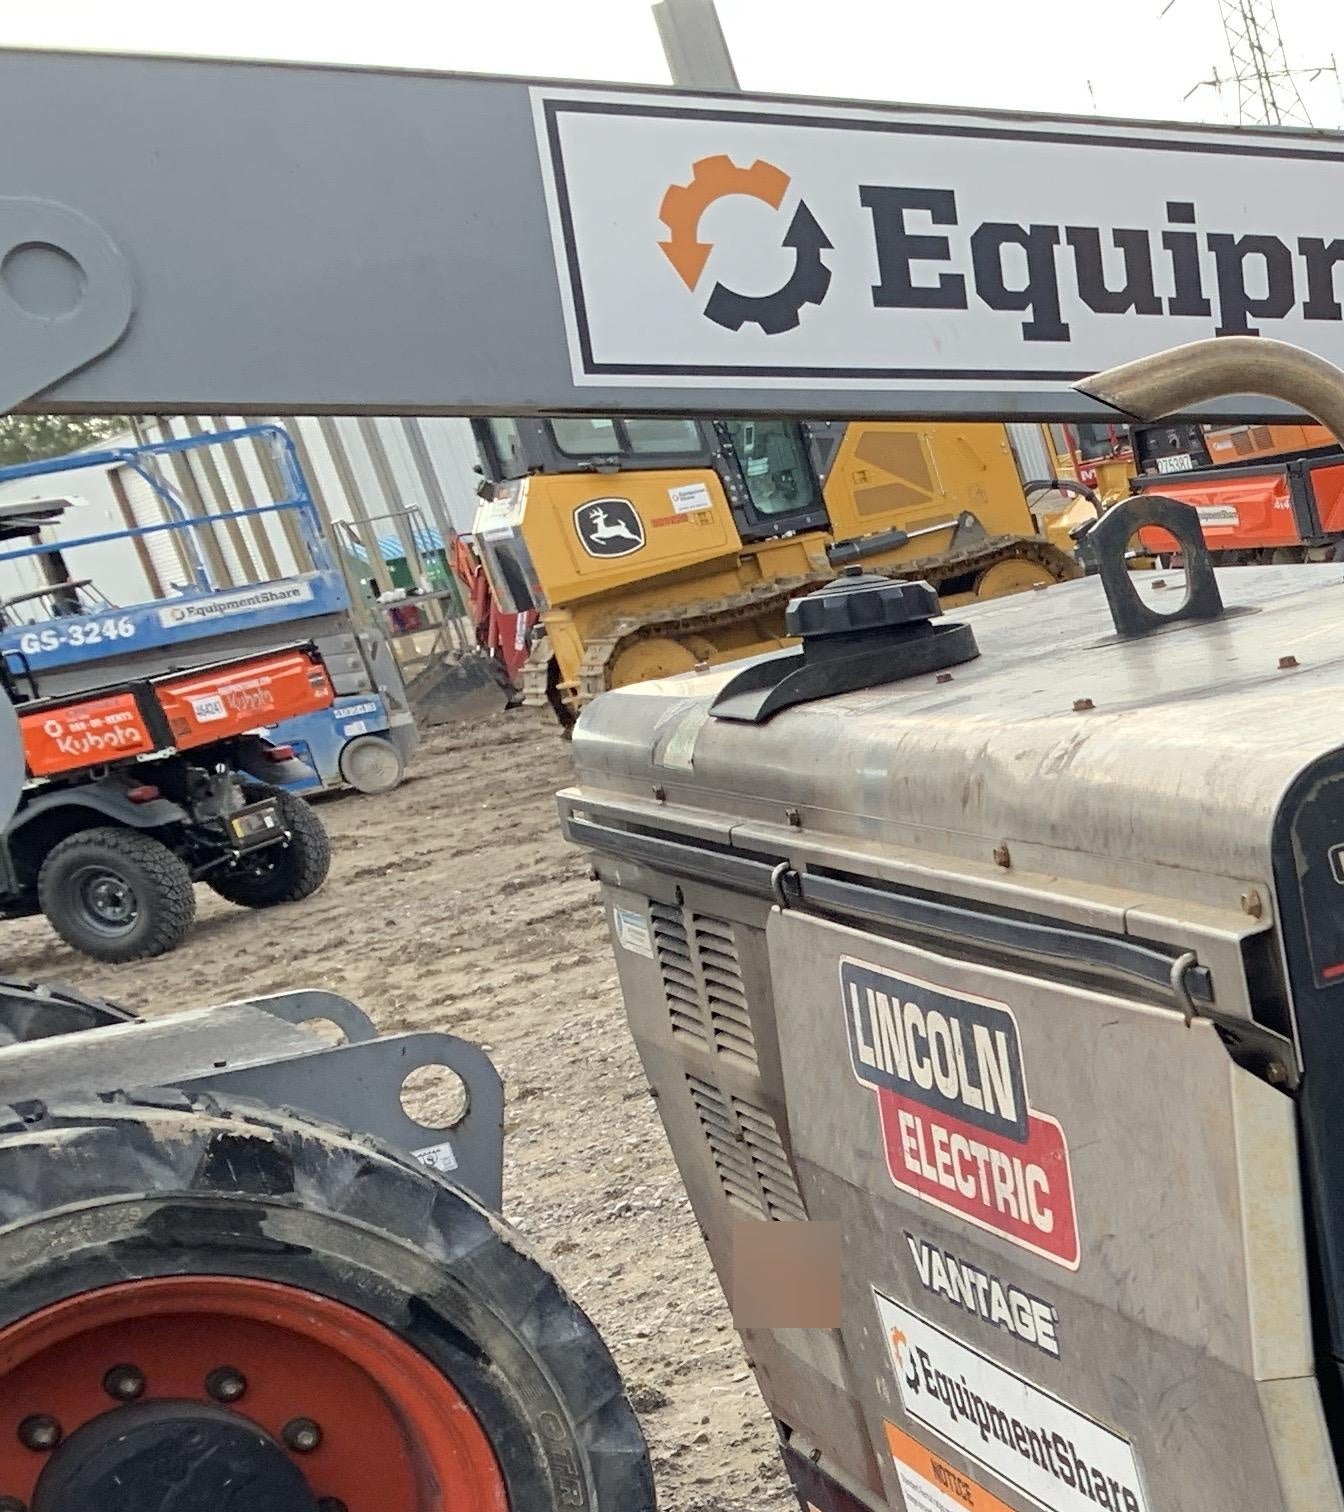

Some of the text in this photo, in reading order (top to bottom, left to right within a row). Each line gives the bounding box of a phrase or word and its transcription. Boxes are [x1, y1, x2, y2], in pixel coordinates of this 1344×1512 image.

[20, 615, 136, 655] GS-3246
[186, 586, 301, 616] EquipmentShare
[56, 725, 142, 756] Kubota
[849, 981, 1018, 1123] LINCOLN
[897, 1108, 1055, 1234] ELECTRIC
[907, 1236, 1060, 1353] VANTAGE
